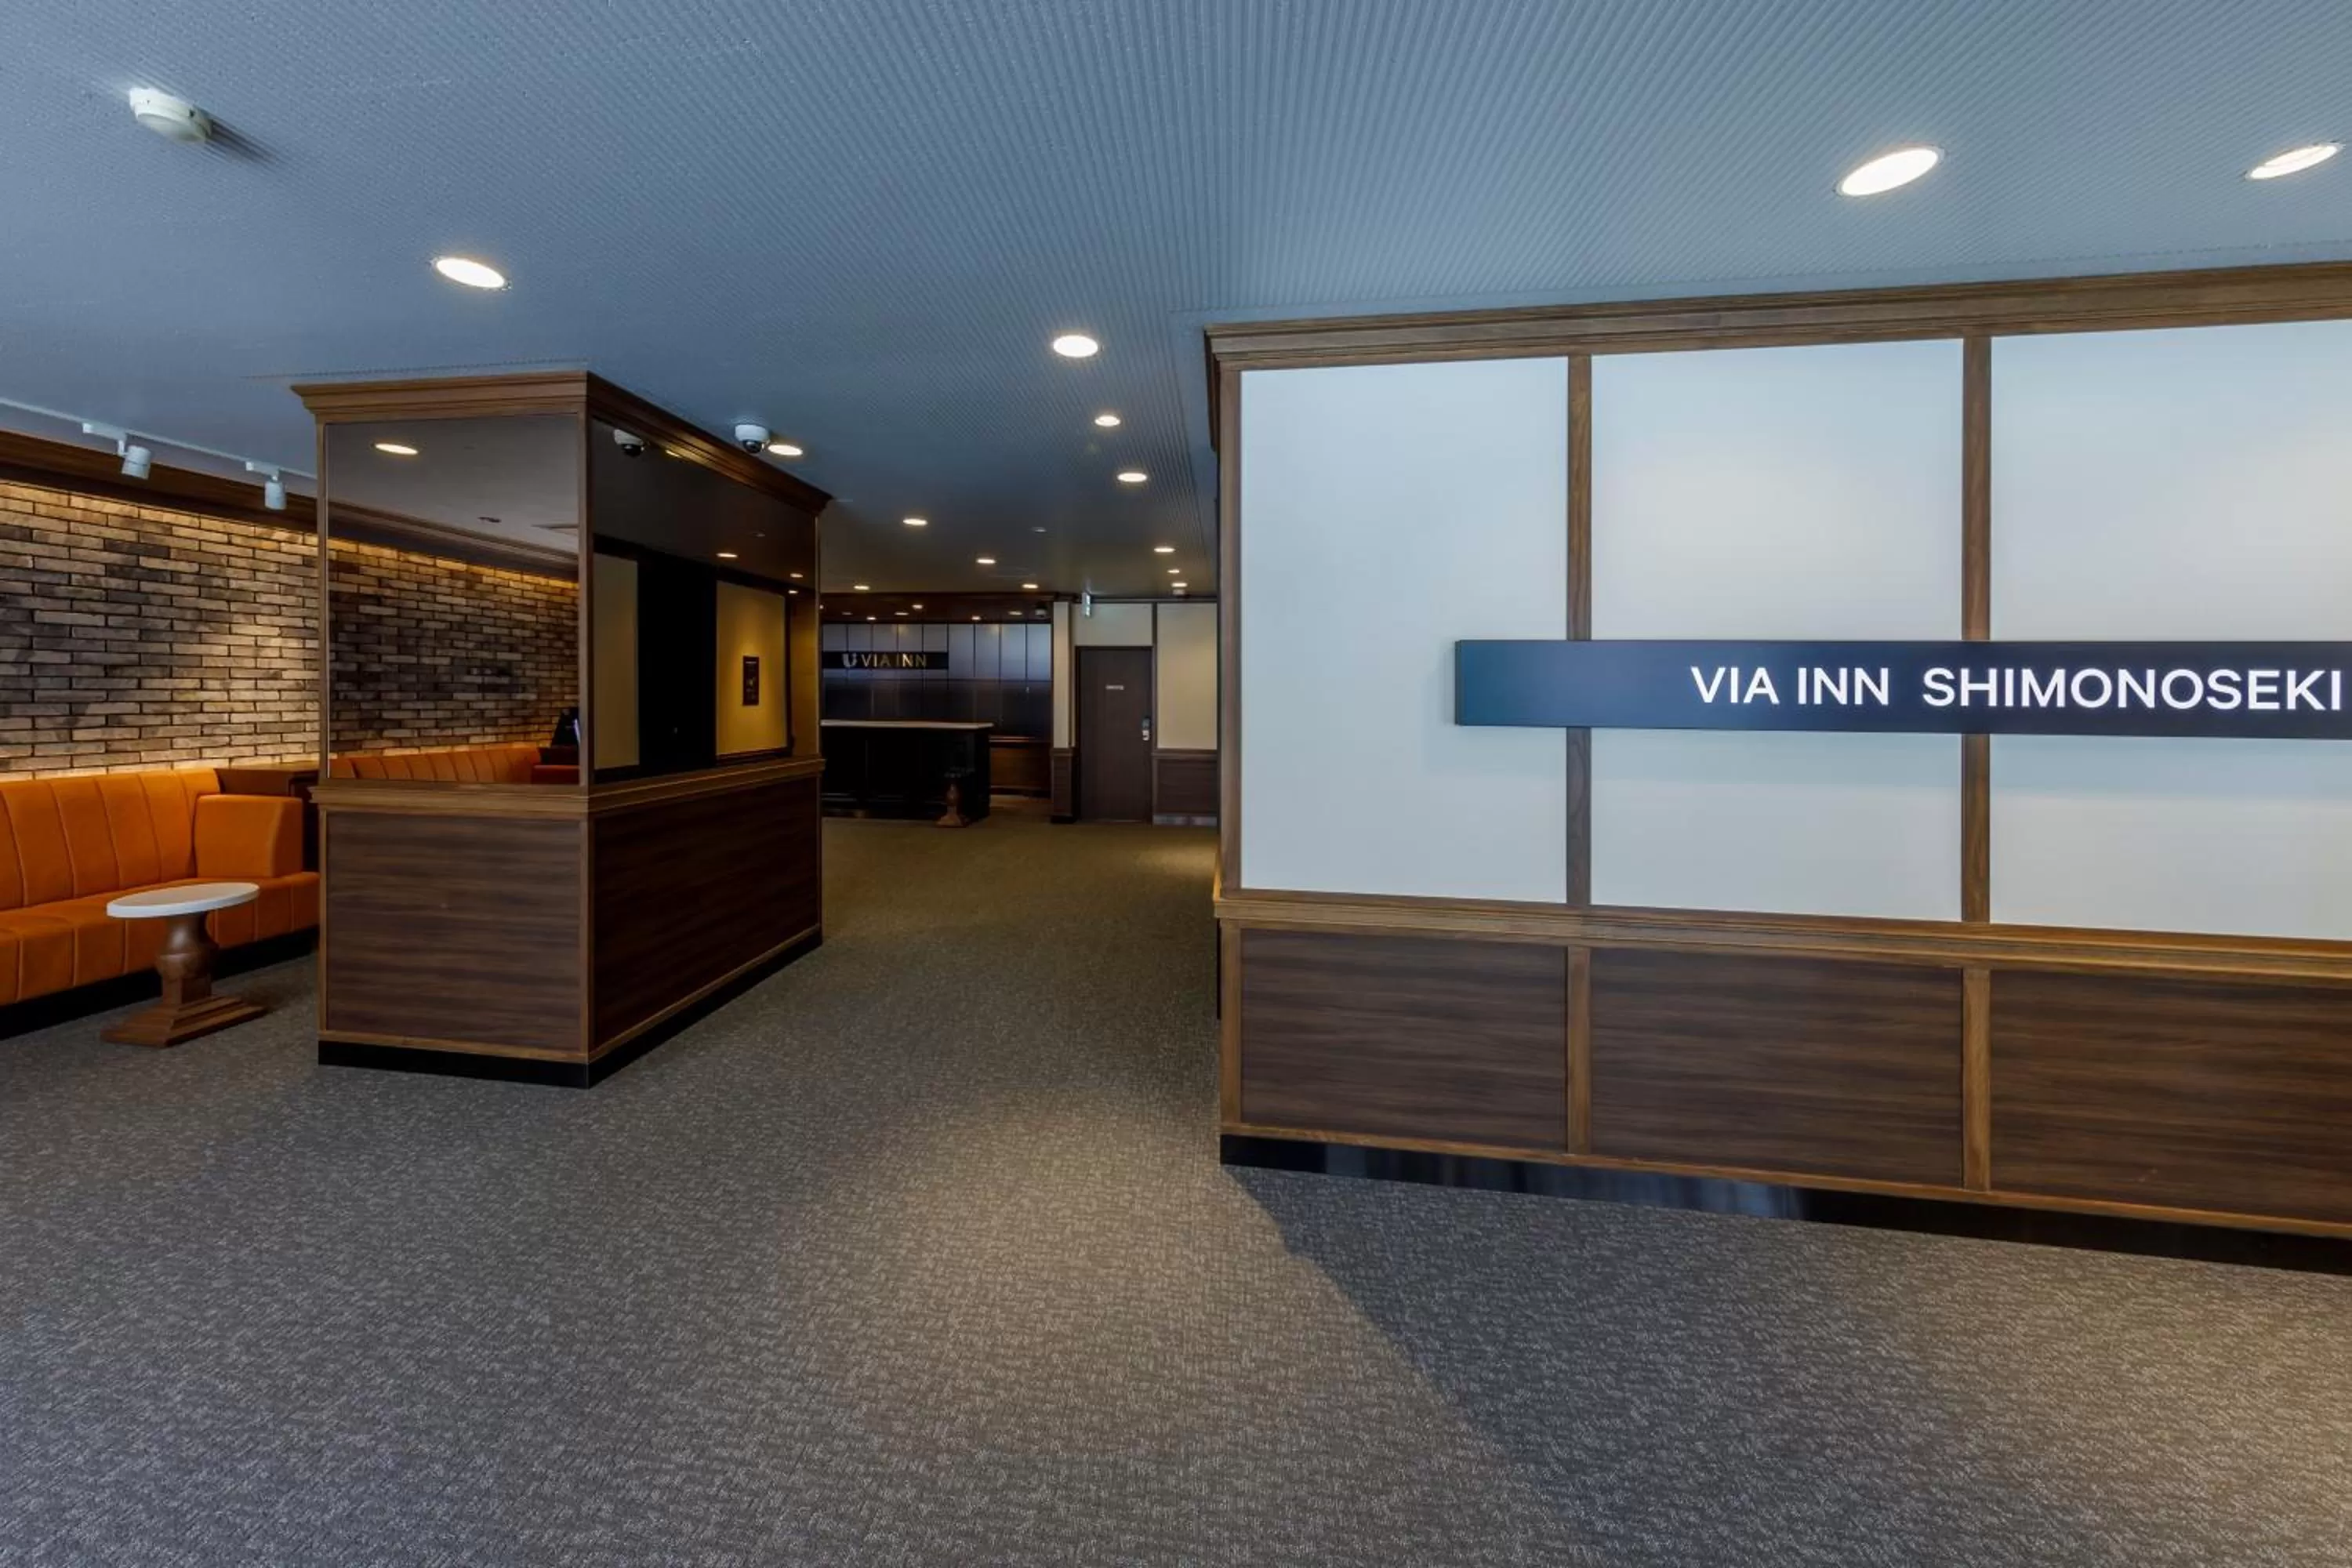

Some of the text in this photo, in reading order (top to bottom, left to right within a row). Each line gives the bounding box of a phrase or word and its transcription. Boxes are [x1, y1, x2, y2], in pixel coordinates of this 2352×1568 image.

[862, 653, 891, 667] VIA
[896, 653, 926, 667] INN
[1690, 666, 2341, 710] VIA INN SHIMONOSEKI
